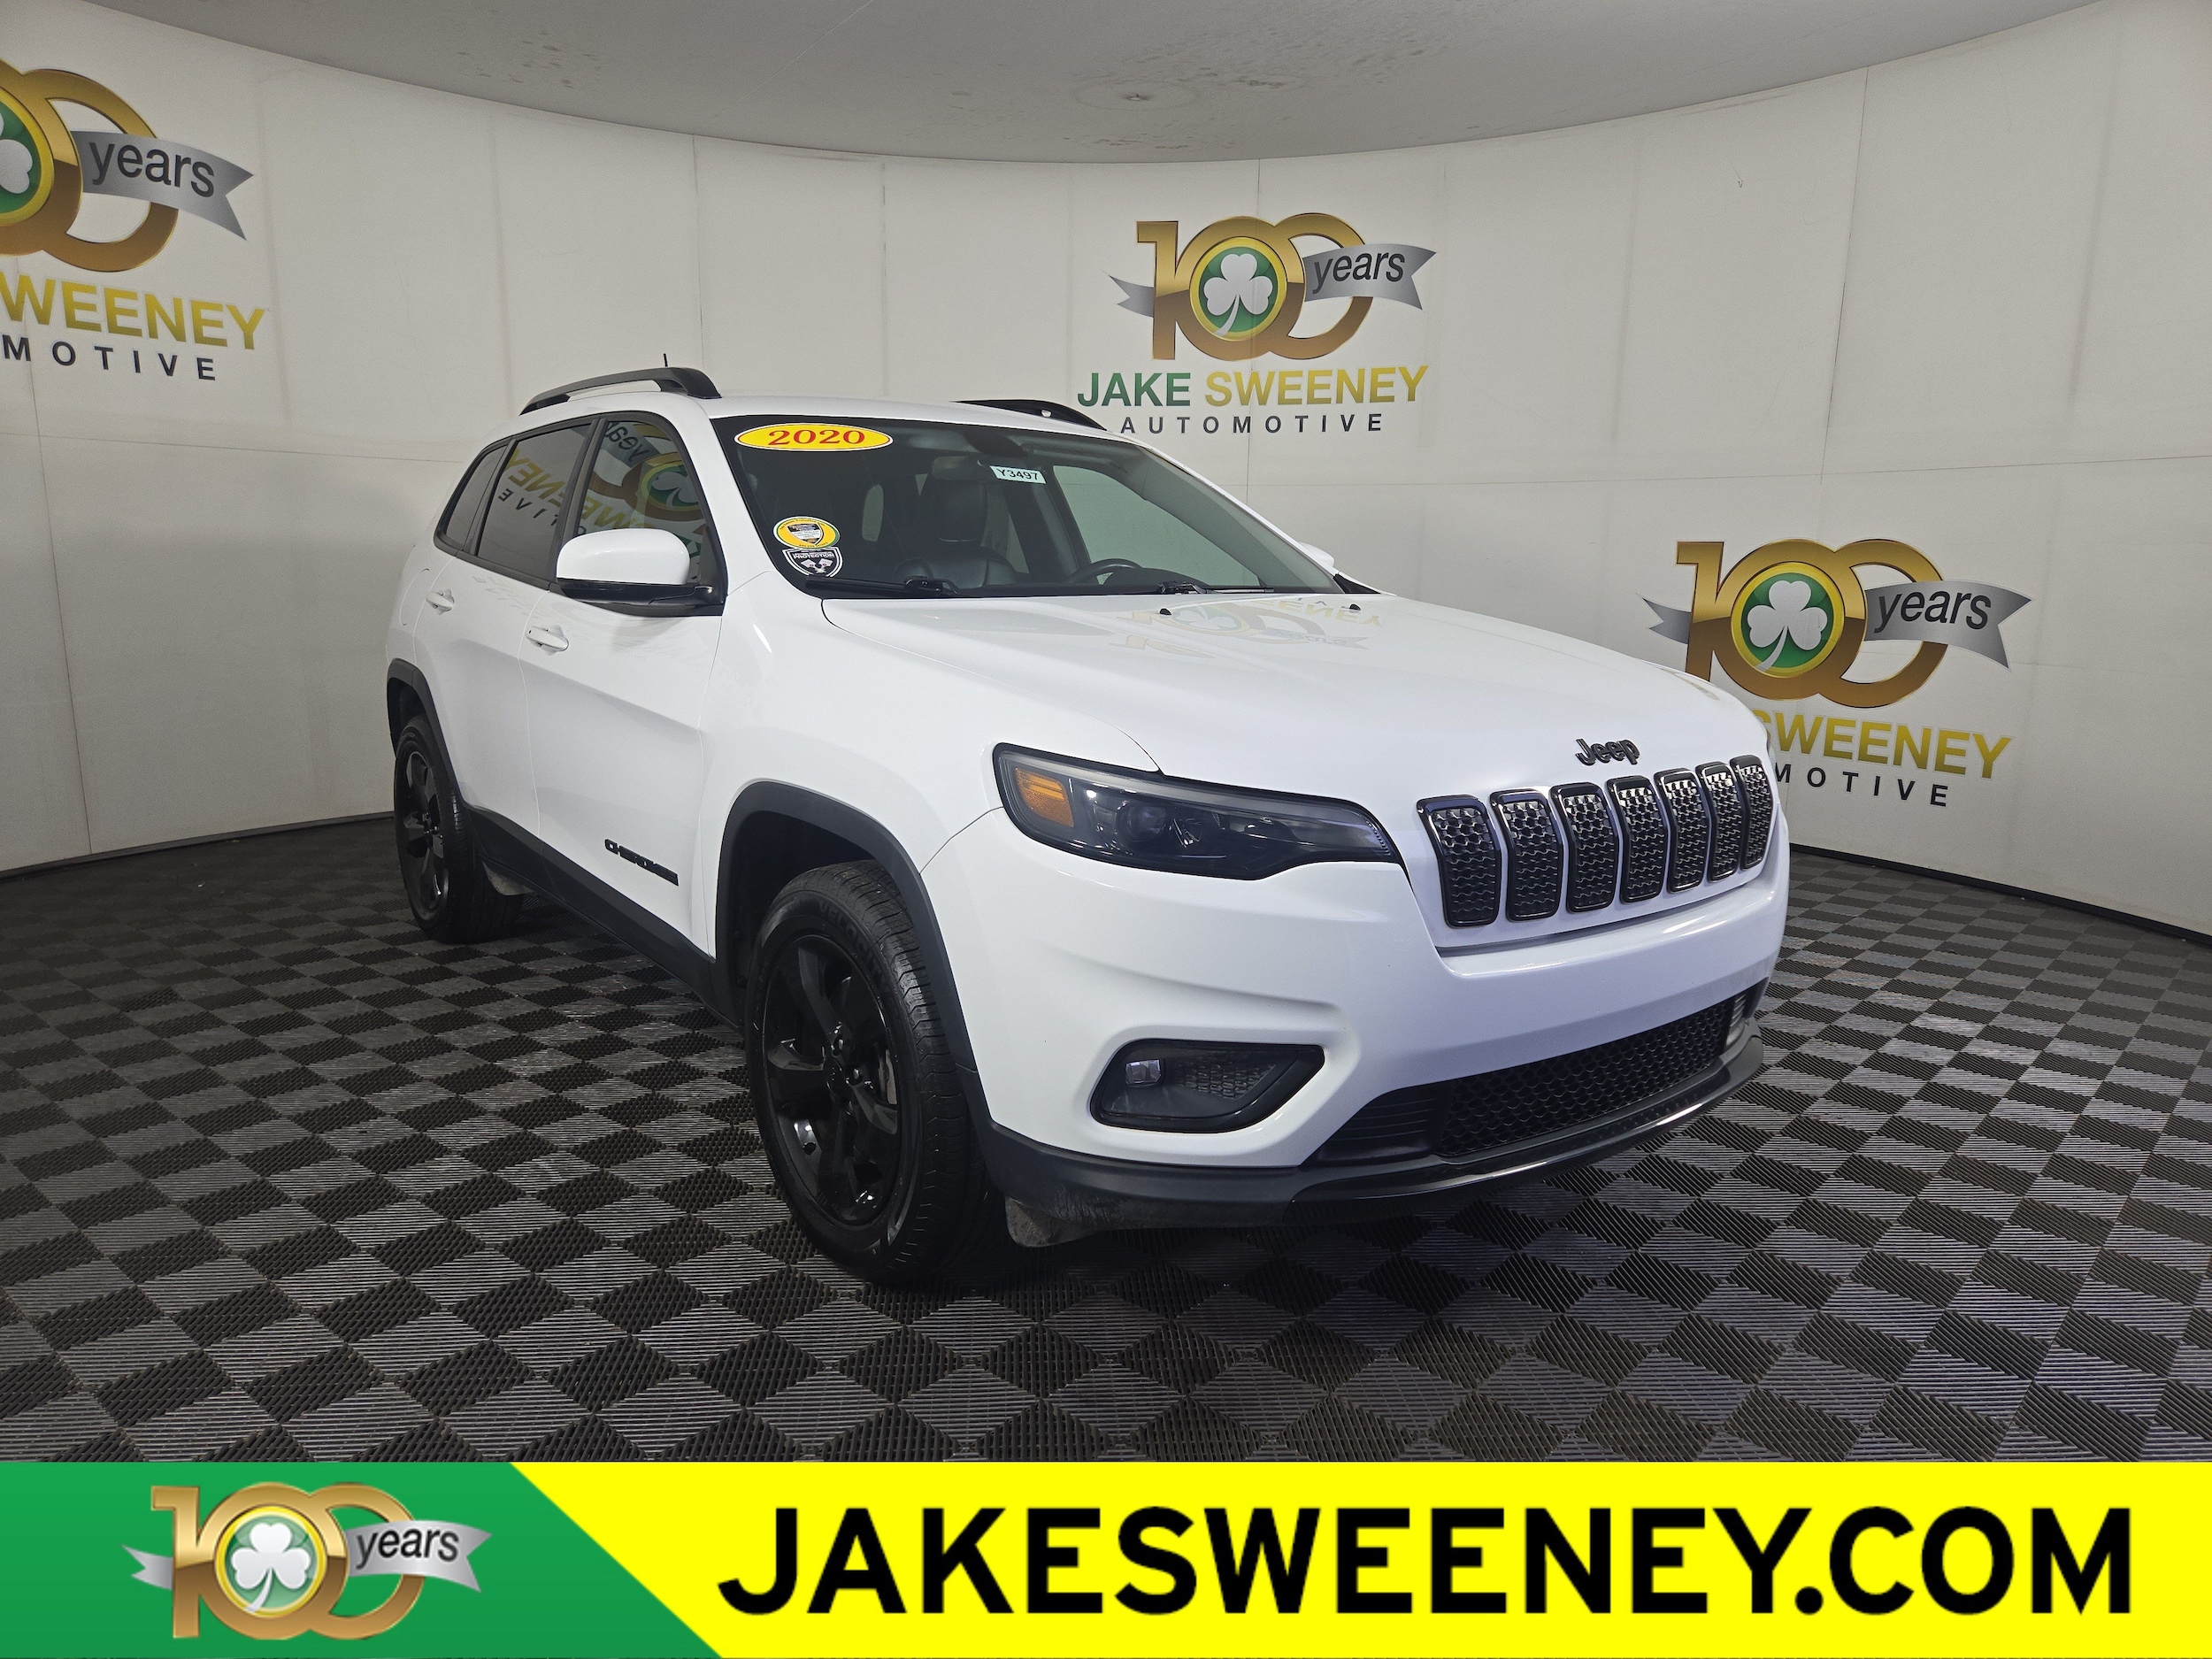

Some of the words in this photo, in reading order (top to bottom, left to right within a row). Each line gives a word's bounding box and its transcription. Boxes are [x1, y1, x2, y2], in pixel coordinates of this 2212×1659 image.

[88, 142, 215, 197] years
[1313, 251, 1405, 294] years
[0, 271, 265, 349] WEENEY
[2, 334, 215, 380] MOTIVE
[1077, 372, 1191, 407] JAKE
[1205, 365, 1429, 406] SWEENEY
[768, 429, 864, 445] 2020
[1120, 413, 1382, 434] AUTOMOTIVE
[996, 468, 1038, 480] Y3497
[1874, 590, 1992, 634] years
[1575, 738, 1640, 765] Jeep
[1775, 763, 1948, 807] MOTIVE
